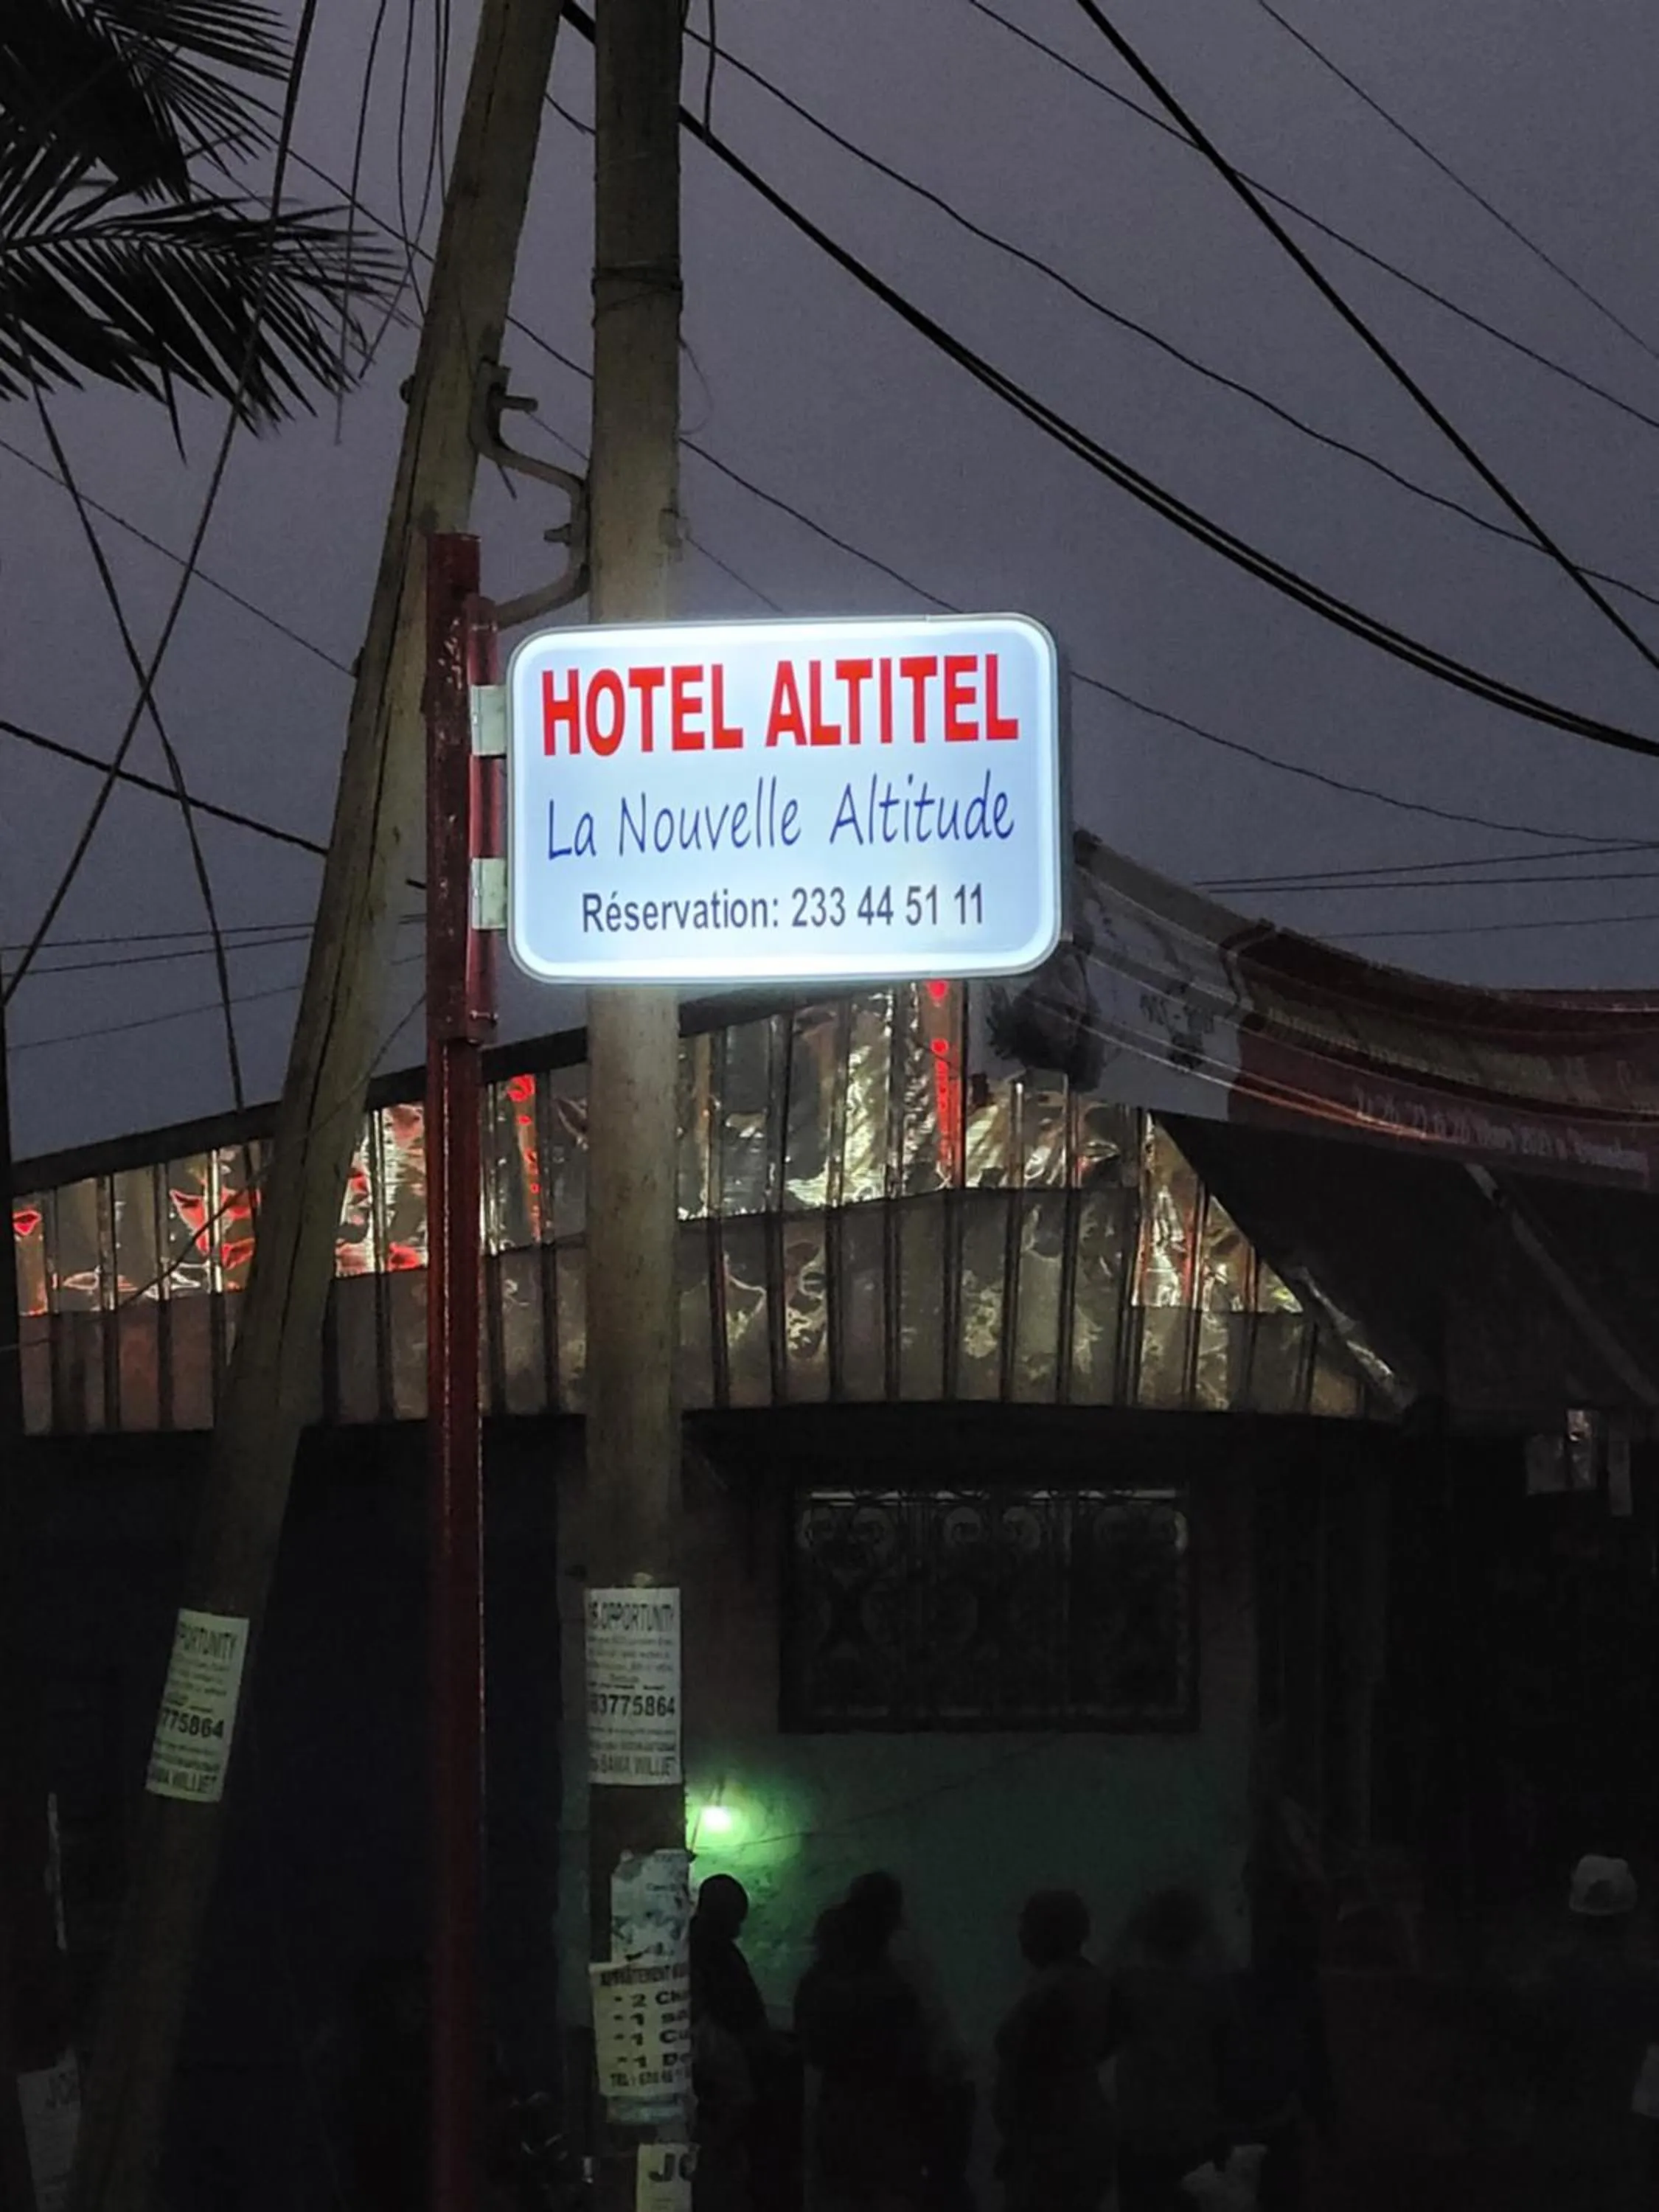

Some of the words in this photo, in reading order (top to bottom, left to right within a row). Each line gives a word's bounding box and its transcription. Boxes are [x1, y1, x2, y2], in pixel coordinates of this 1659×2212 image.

[543, 666, 742, 755] HOTEL
[767, 655, 1018, 746] ALTITEL
[549, 800, 596, 860] La
[619, 776, 801, 856] Nouvelle
[830, 770, 1014, 845] Altitude
[582, 888, 778, 932] Réservation:
[792, 887, 845, 927] 233
[858, 886, 894, 925] 44
[906, 885, 936, 925] 51
[955, 883, 981, 925] 11
